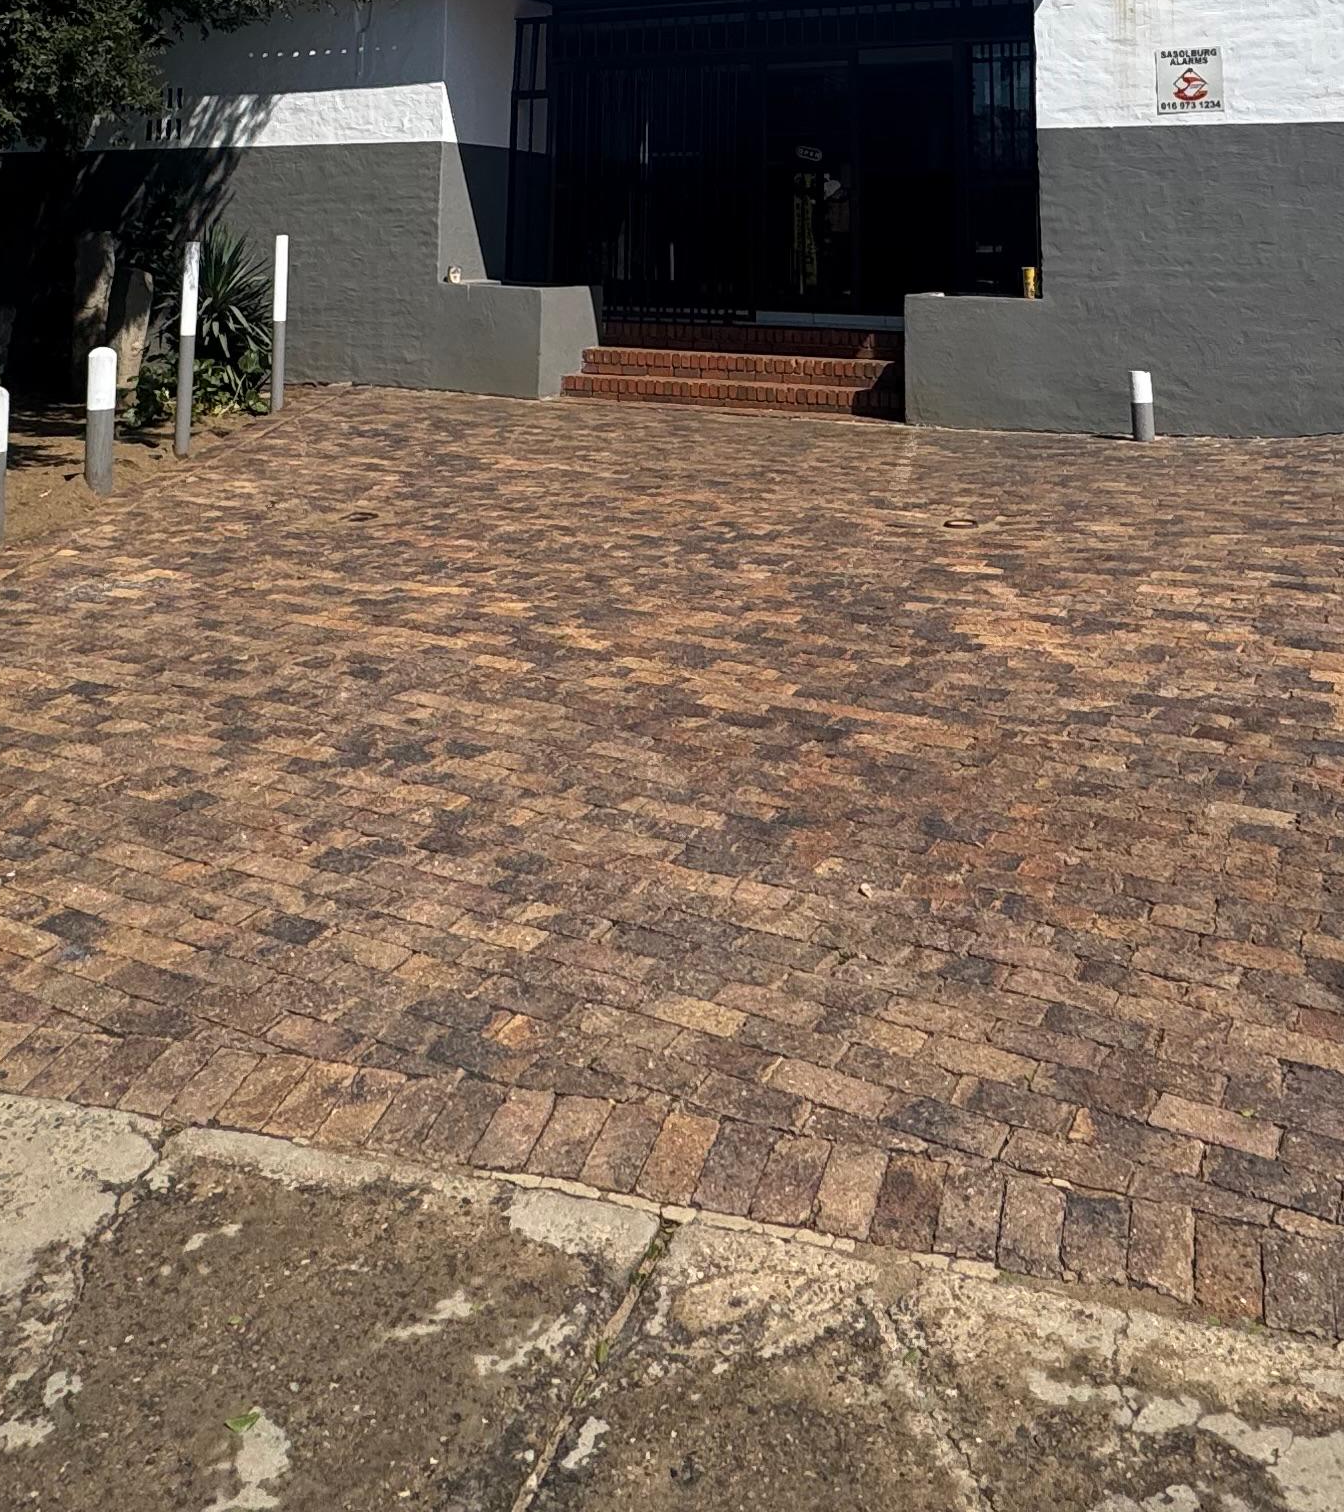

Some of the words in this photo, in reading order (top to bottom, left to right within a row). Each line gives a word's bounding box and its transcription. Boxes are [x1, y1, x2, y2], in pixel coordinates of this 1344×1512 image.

[1160, 48, 1217, 59] SASOLBURG
[1169, 56, 1208, 66] ALARMS
[1160, 101, 1178, 110] 016
[1199, 99, 1221, 109] 1234
